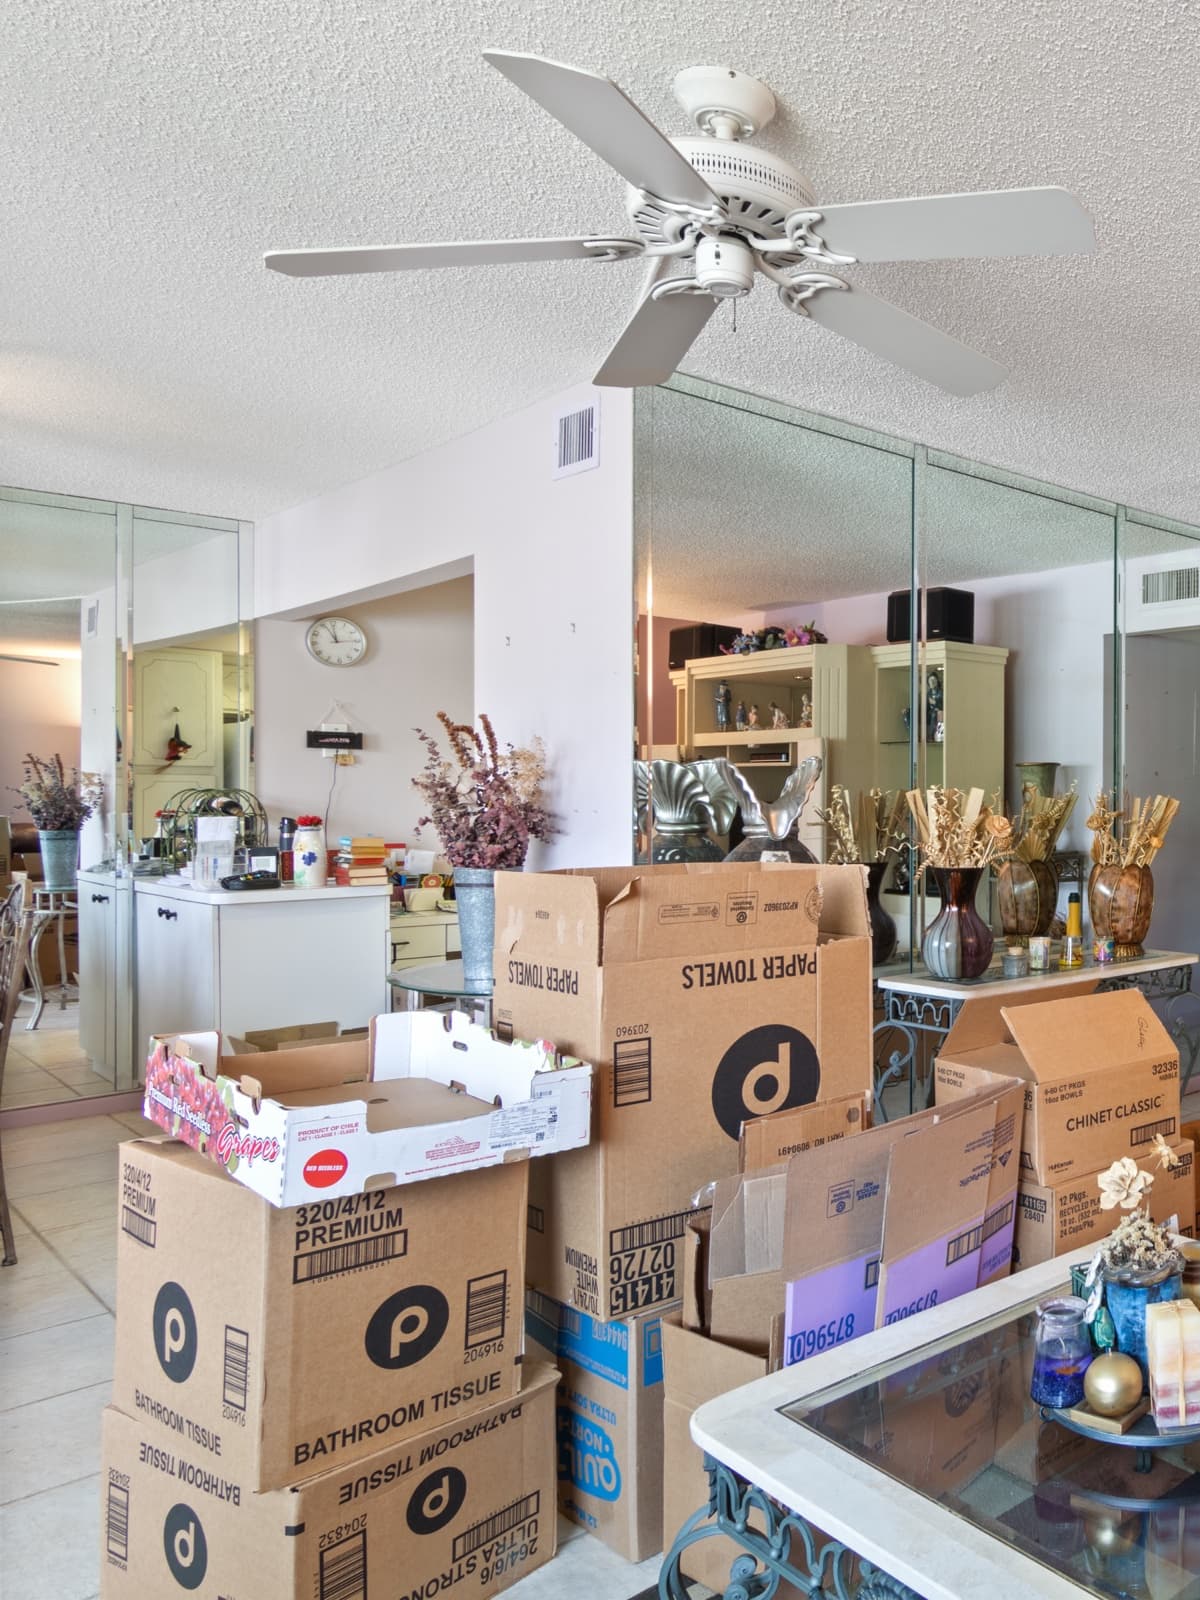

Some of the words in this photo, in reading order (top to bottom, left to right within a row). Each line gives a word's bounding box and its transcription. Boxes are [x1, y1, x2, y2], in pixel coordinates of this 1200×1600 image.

[508, 960, 544, 989] TOWELS
[546, 965, 579, 996] PAPER
[681, 958, 758, 990] TOWELS
[762, 951, 817, 979] PAPER
[616, 1022, 649, 1038] 203960
[1152, 1060, 1178, 1075] 32336
[1066, 1108, 1113, 1131] CHINET
[1115, 1095, 1161, 1119] CLASSIC
[217, 1122, 280, 1168] Grapes
[777, 1141, 810, 1156] 9090491
[123, 1162, 152, 1193] 320/4/12
[122, 1184, 156, 1218] PREMIUM
[295, 1189, 386, 1228] 320/4/12
[1023, 1208, 1045, 1223] 28401
[295, 1207, 403, 1251] PREMIUM
[564, 1246, 598, 1276] PREMIUM
[609, 1242, 675, 1285] 02726
[576, 1269, 599, 1296] WHITE
[610, 1272, 674, 1316] 41415
[463, 1340, 504, 1365] 204916
[134, 1388, 185, 1437] BATHROOM
[185, 1414, 222, 1457] TISSUE
[294, 1399, 425, 1466] BATHROOM
[431, 1370, 502, 1412] TISSUE
[589, 1398, 617, 1427] ULTRA
[418, 1402, 523, 1466] BATHROOM
[139, 1442, 176, 1477] TISSUE
[178, 1458, 241, 1507] BATHROOM
[338, 1455, 413, 1505] TISSUE
[318, 1512, 367, 1549] 204832
[482, 1518, 539, 1563] ULTRA
[480, 1537, 538, 1585] 264/6/6
